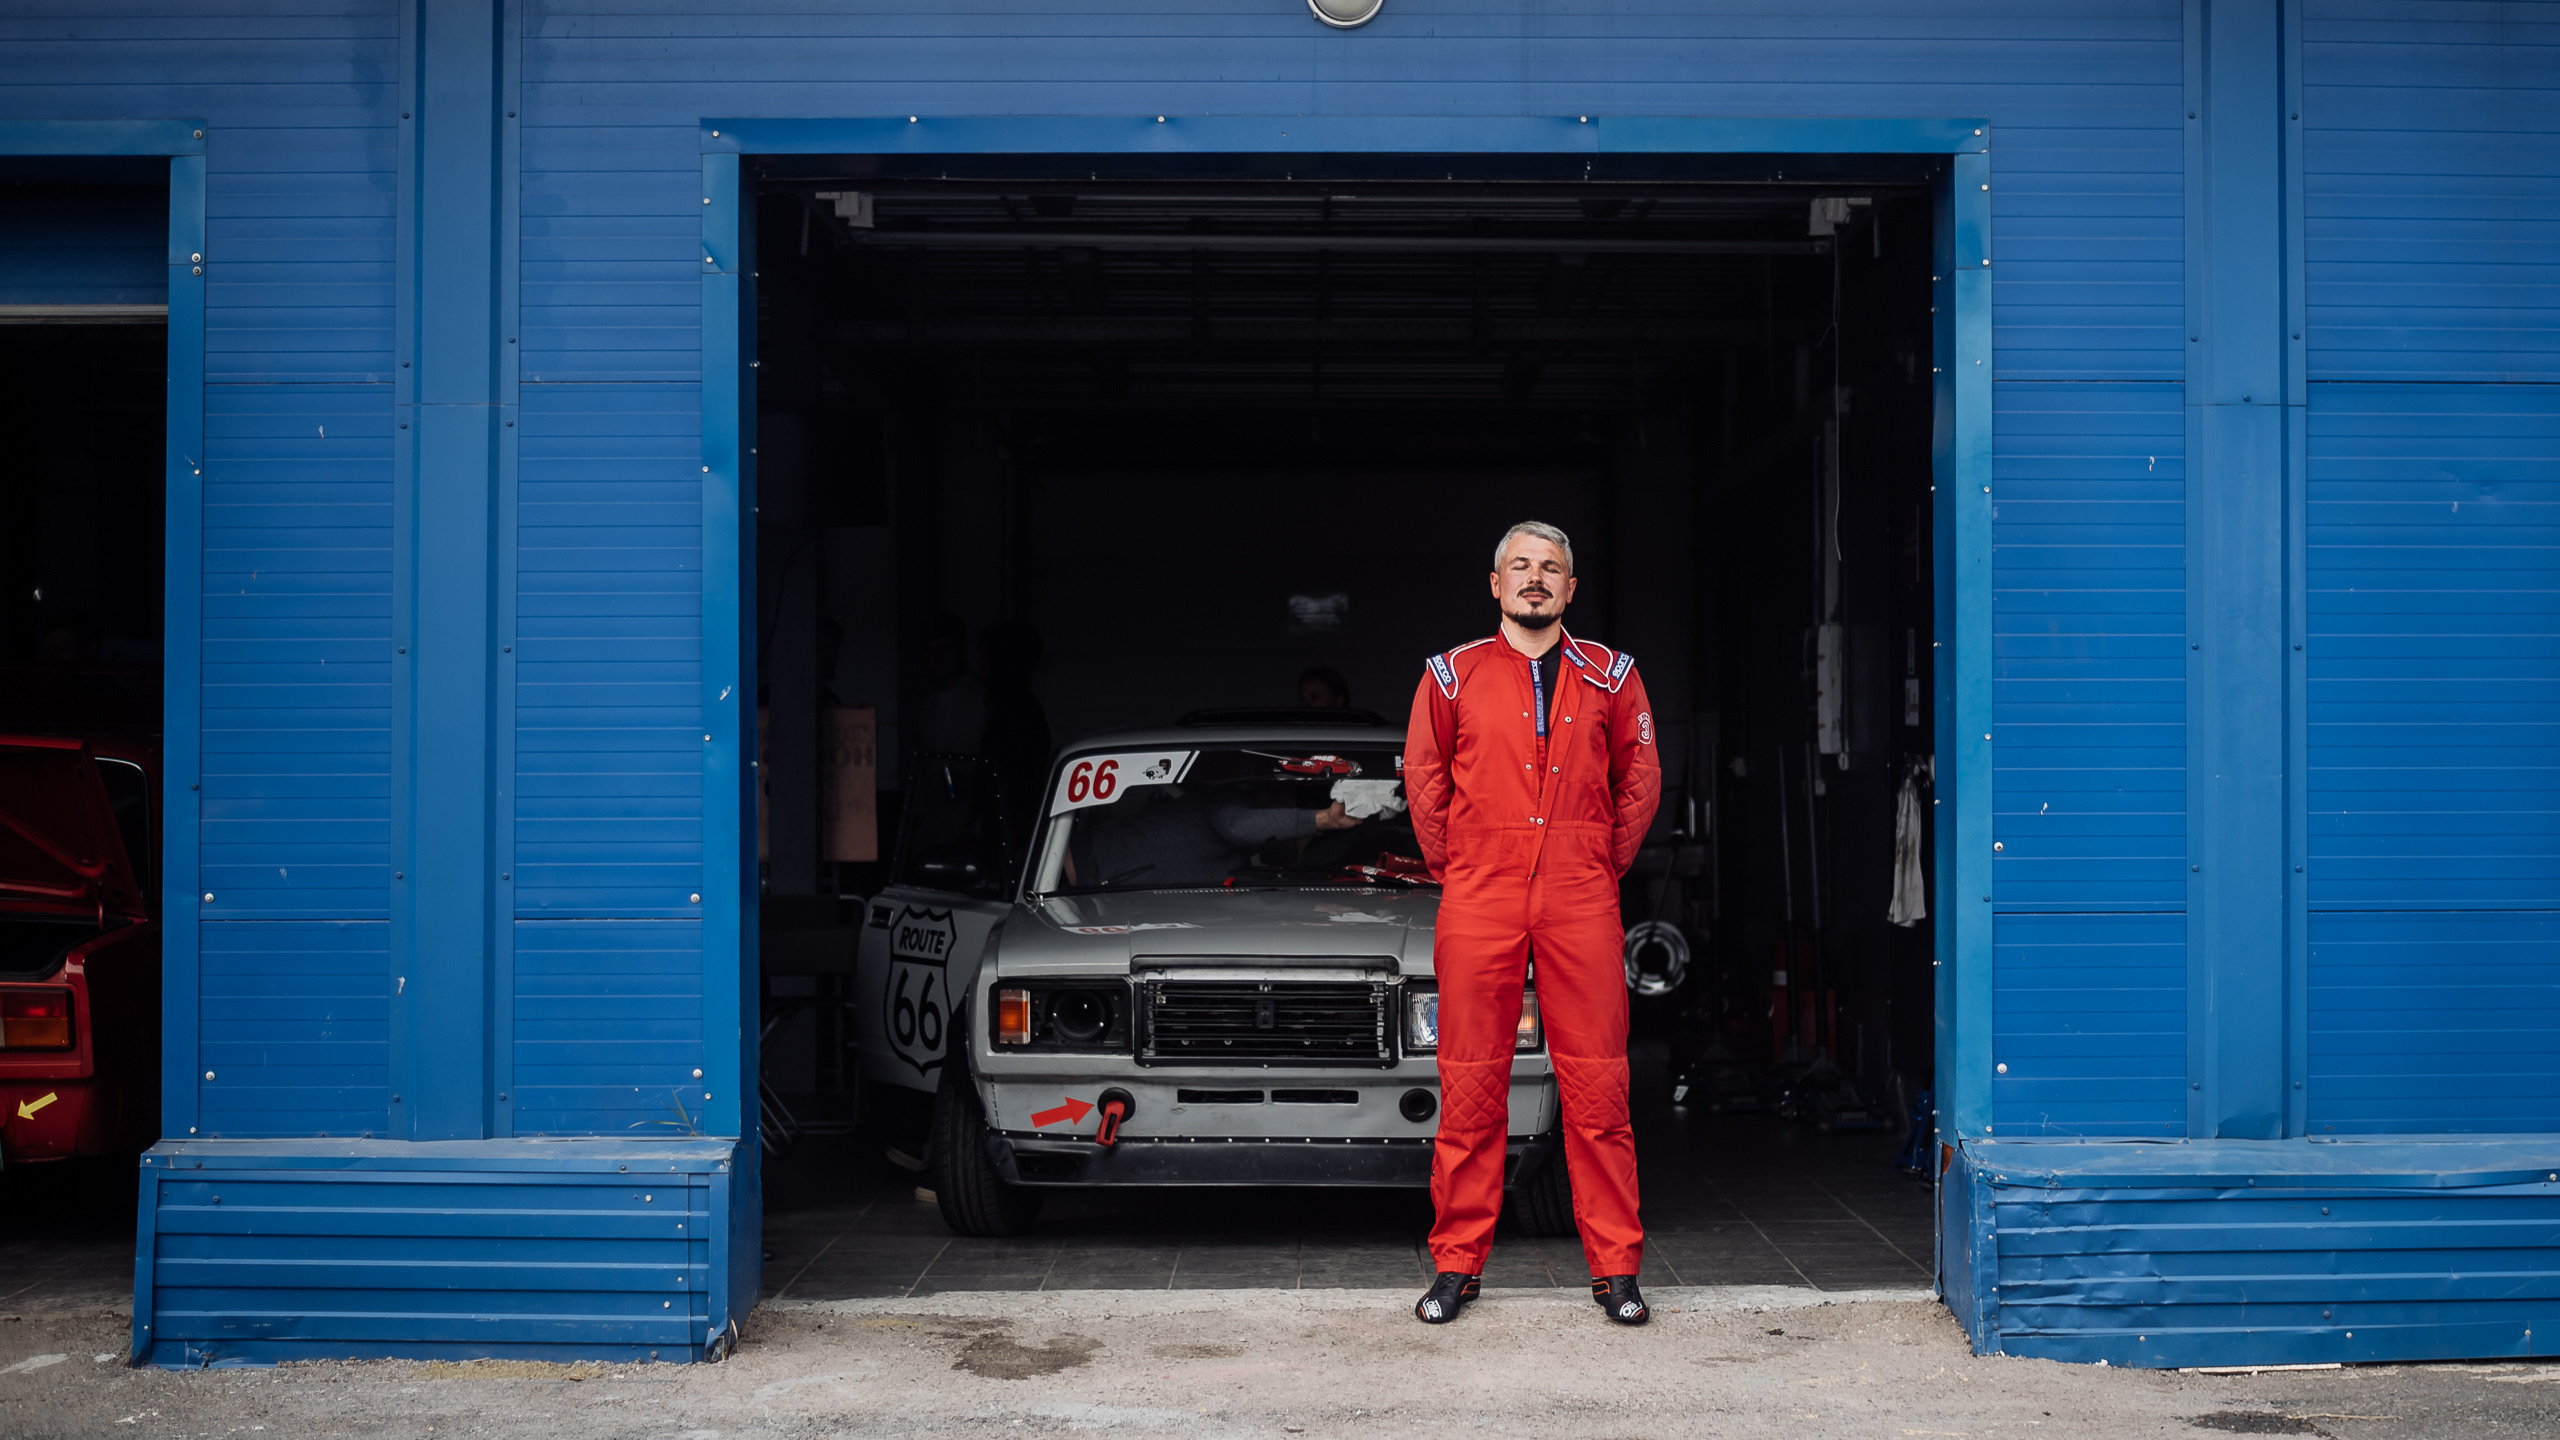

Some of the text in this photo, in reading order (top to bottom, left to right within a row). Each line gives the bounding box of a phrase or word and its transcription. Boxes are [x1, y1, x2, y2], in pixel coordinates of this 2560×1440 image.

[1068, 760, 1119, 803] 66
[900, 926, 946, 954] ROUTE
[894, 967, 942, 1052] 66
